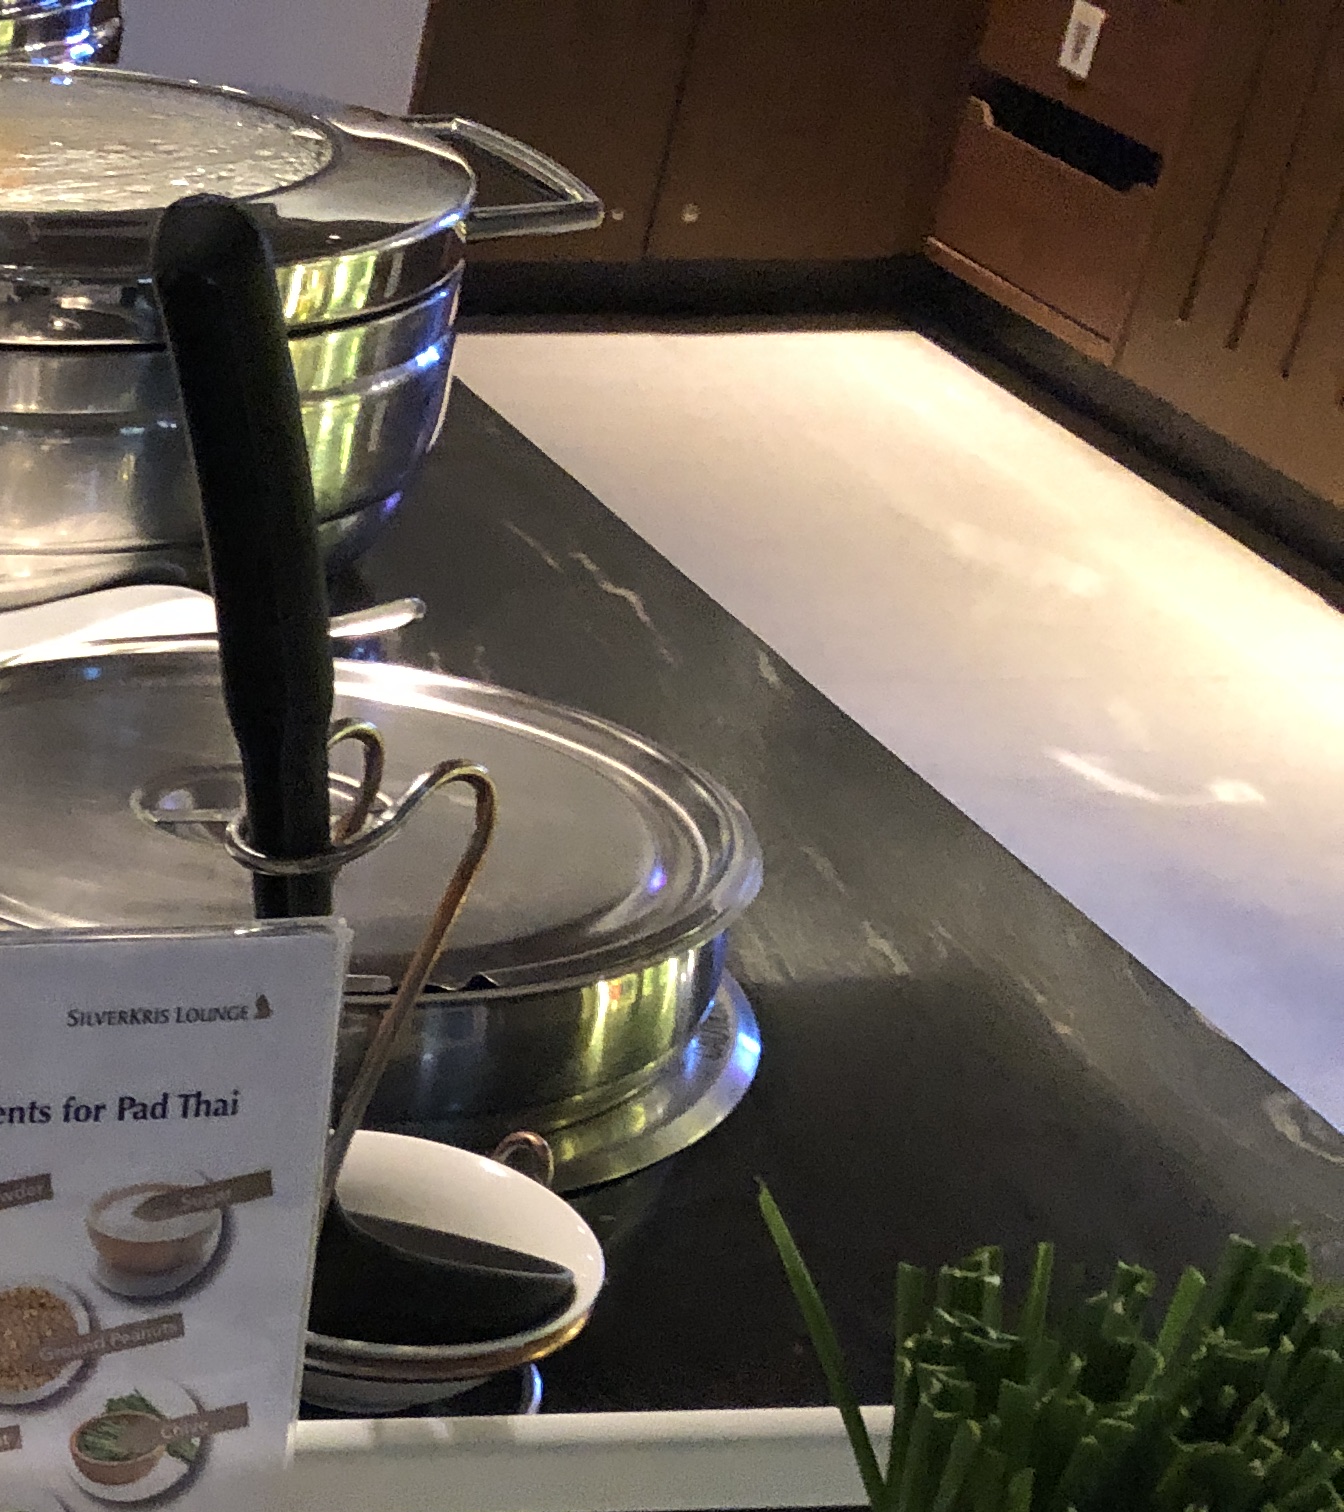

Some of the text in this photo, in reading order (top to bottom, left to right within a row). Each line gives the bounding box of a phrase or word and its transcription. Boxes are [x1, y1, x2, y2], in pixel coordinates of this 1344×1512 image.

[175, 1004, 250, 1024] LOUNGE
[62, 1096, 108, 1124] for
[116, 1093, 169, 1122] Pad
[179, 1089, 240, 1120] Thai
[38, 1323, 179, 1362] Ground Peanuts
